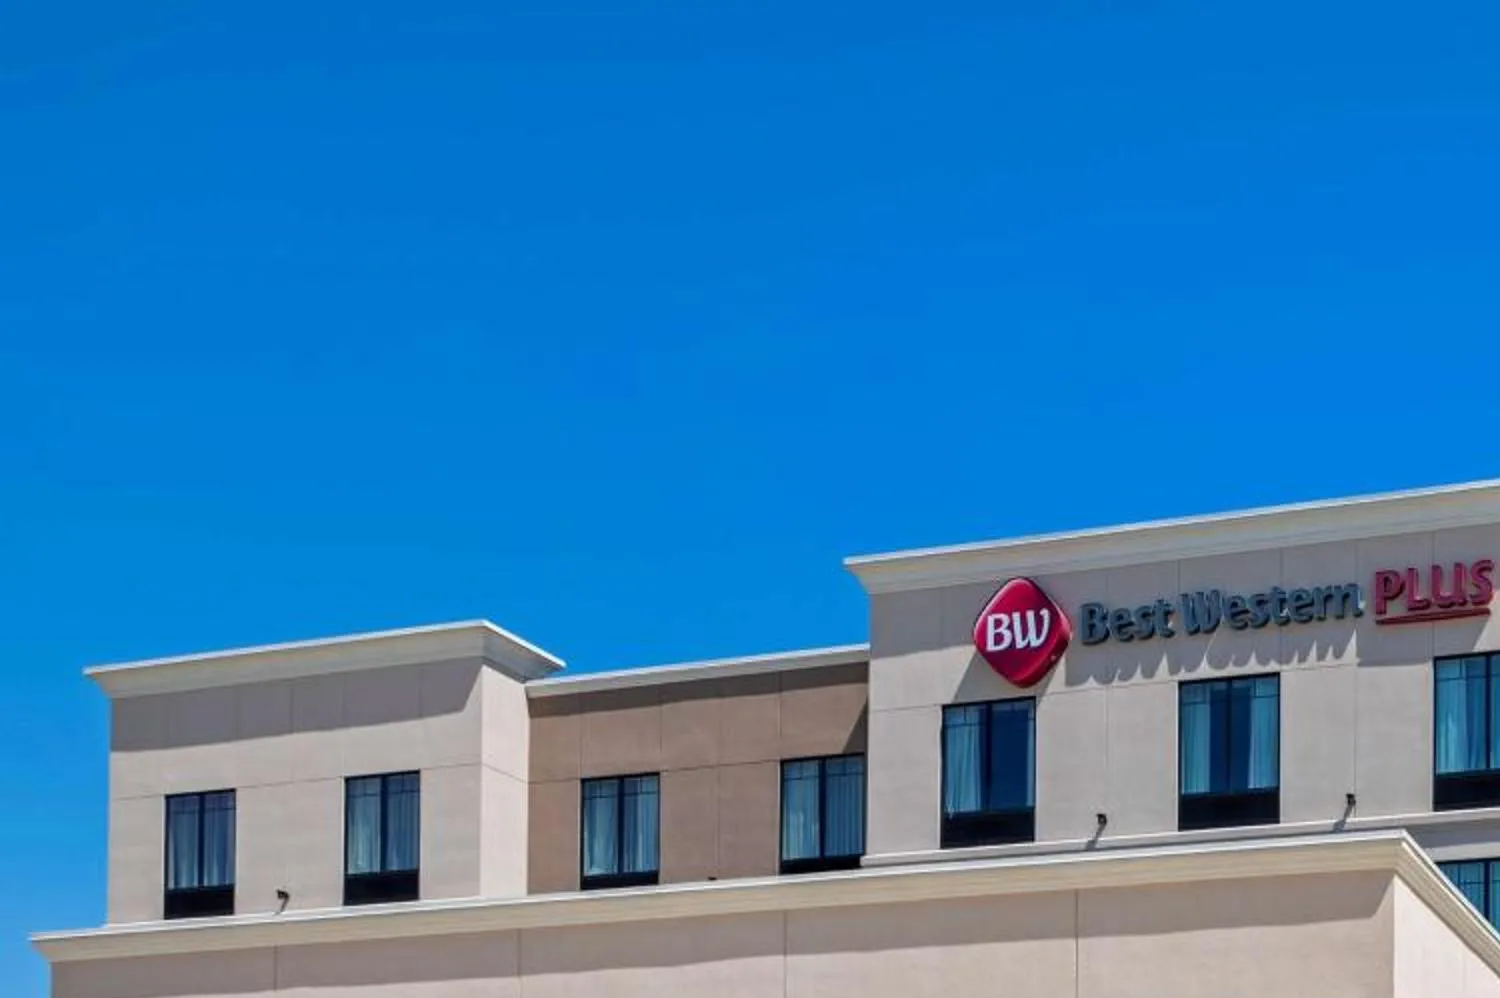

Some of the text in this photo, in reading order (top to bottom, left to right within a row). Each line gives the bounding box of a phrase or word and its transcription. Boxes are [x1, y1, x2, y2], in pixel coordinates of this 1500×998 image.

[985, 607, 1051, 652] BW
[1079, 559, 1496, 645] Best Western PLUS
